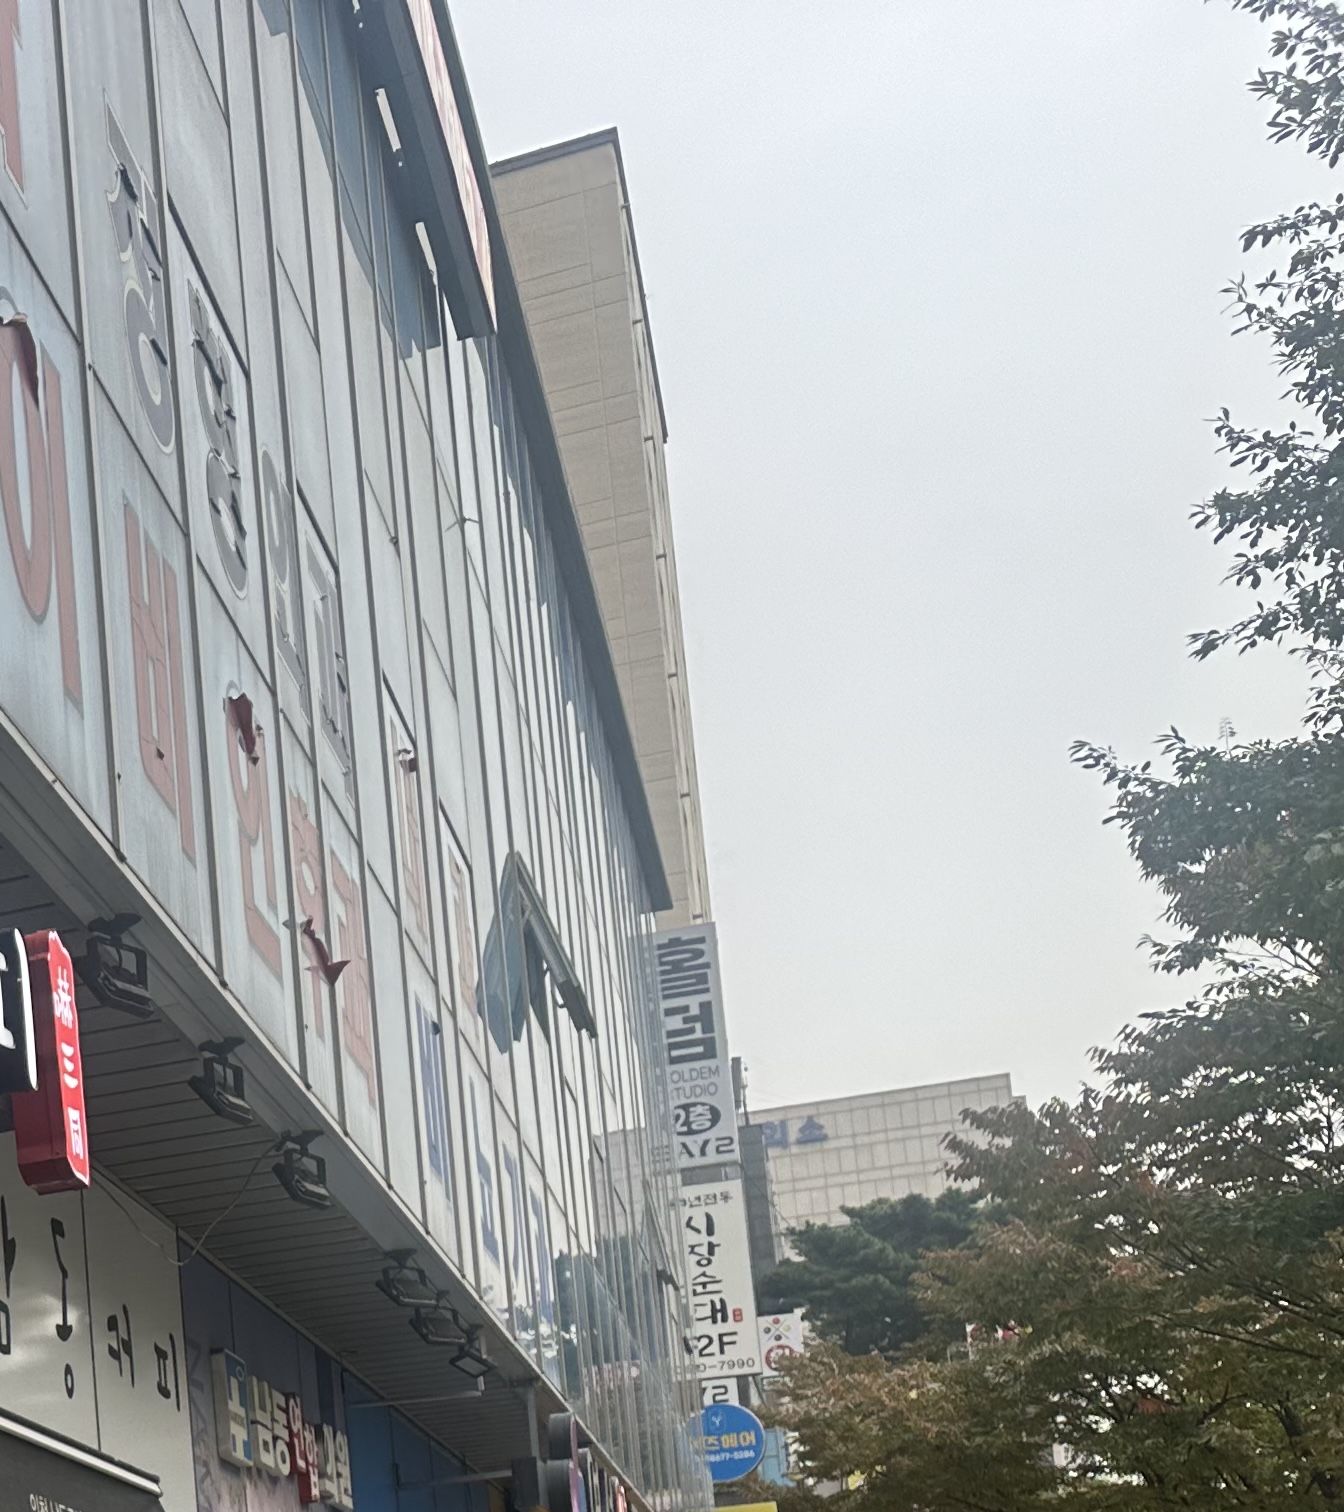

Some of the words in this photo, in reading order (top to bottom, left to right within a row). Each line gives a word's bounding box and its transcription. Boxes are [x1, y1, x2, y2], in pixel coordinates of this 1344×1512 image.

[671, 1065, 720, 1084] OLDEM
[671, 1082, 718, 1100] TUDIO
[697, 1331, 739, 1358] 2F
